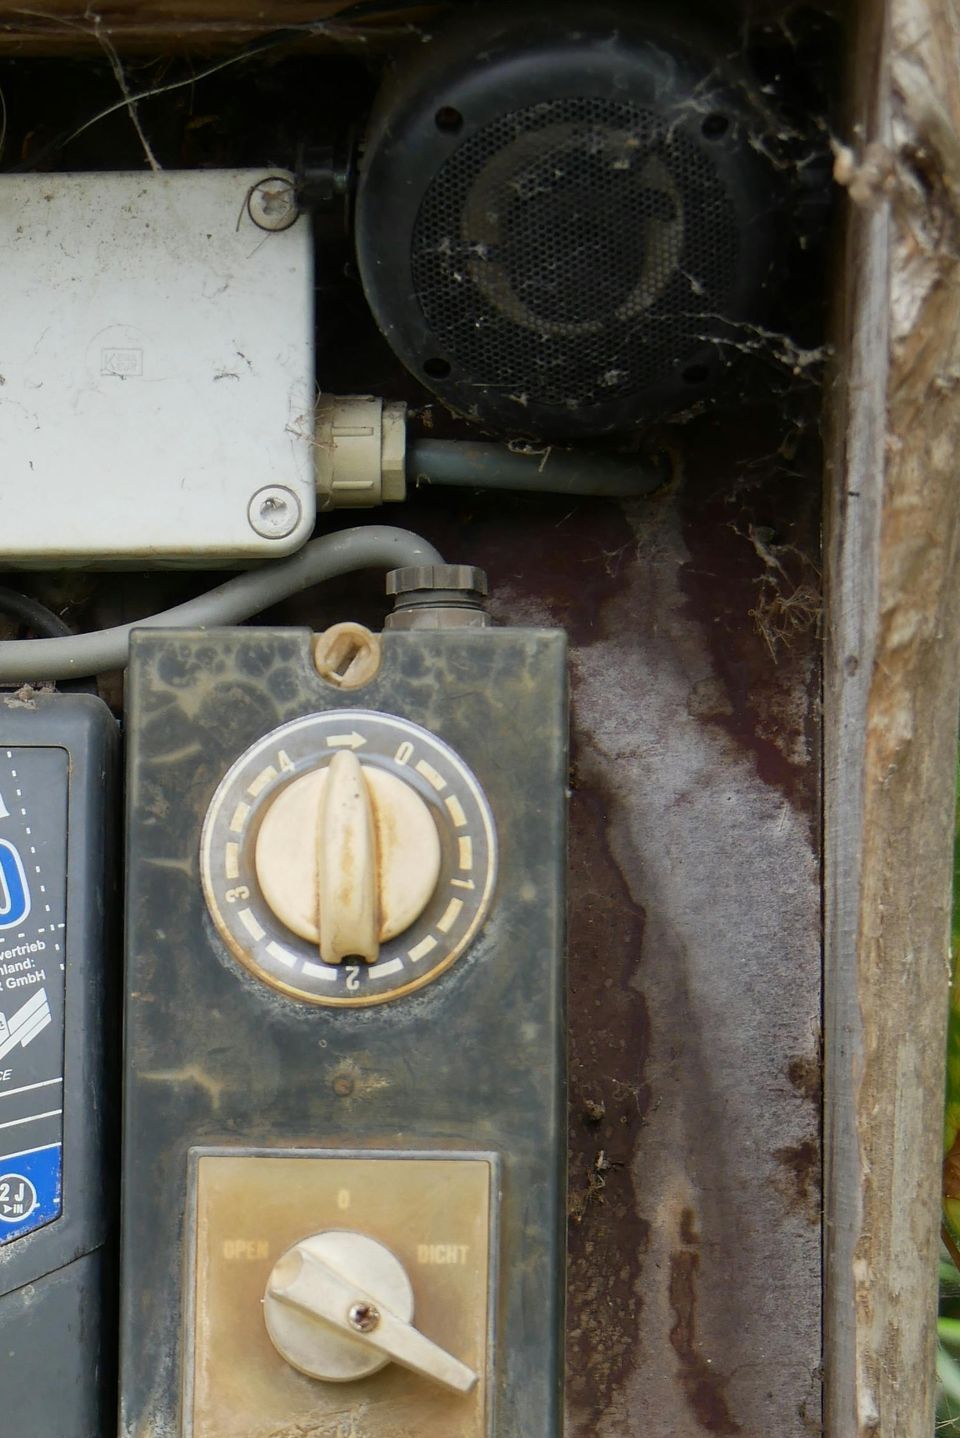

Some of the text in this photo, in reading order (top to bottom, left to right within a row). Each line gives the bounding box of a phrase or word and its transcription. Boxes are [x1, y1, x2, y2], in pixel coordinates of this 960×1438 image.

[279, 751, 295, 771] 4
[395, 742, 414, 765] 0
[226, 886, 249, 902] 3
[450, 879, 475, 889] 1
[5, 969, 46, 989] GmbH
[345, 966, 360, 989] 2
[0, 1183, 24, 1201] 2 J
[223, 1239, 269, 1260] OPEN
[417, 1244, 470, 1264] DICHT
